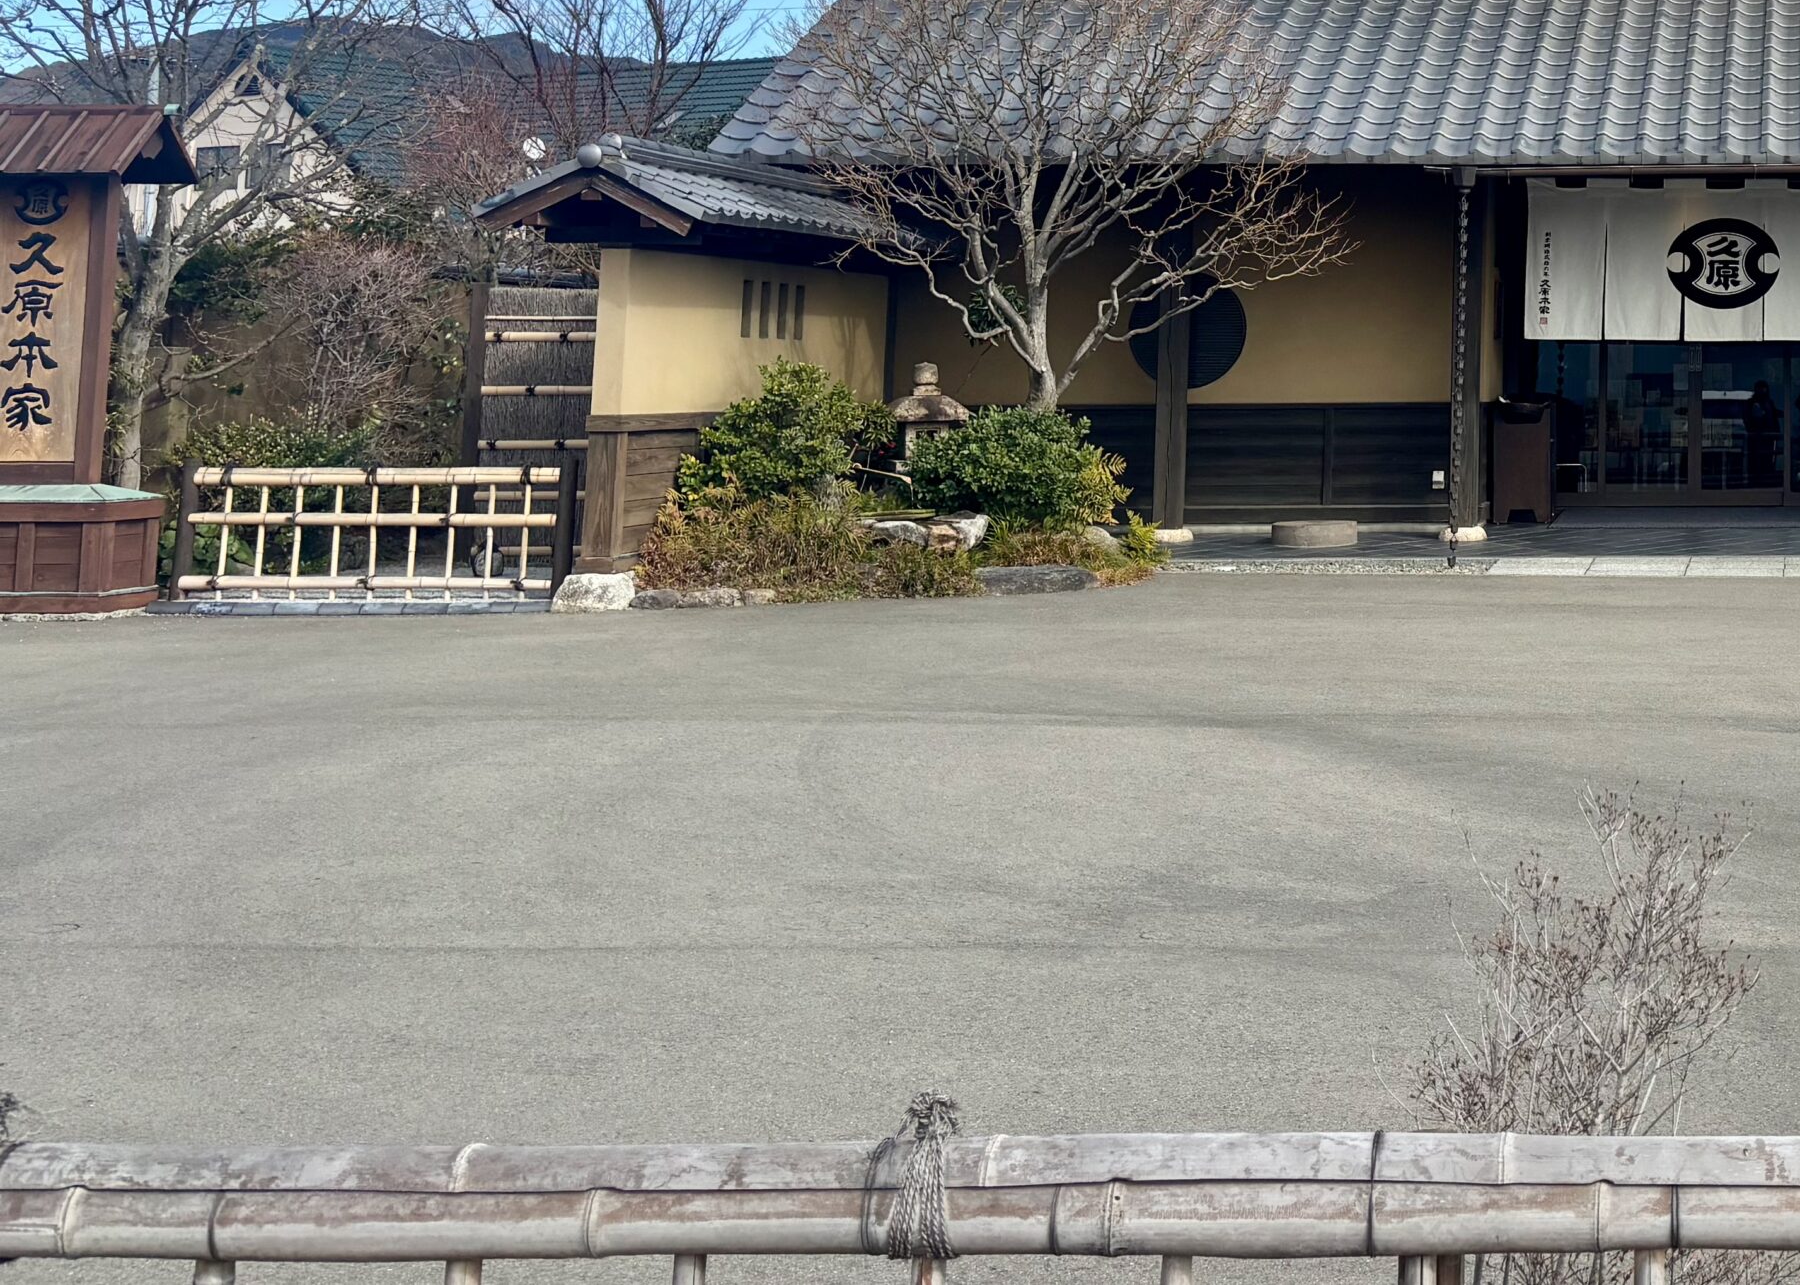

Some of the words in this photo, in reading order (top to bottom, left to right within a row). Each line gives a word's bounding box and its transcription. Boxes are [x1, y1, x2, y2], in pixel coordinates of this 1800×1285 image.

[1706, 236, 1742, 291] 久原
[0, 232, 64, 431] 久原本家
